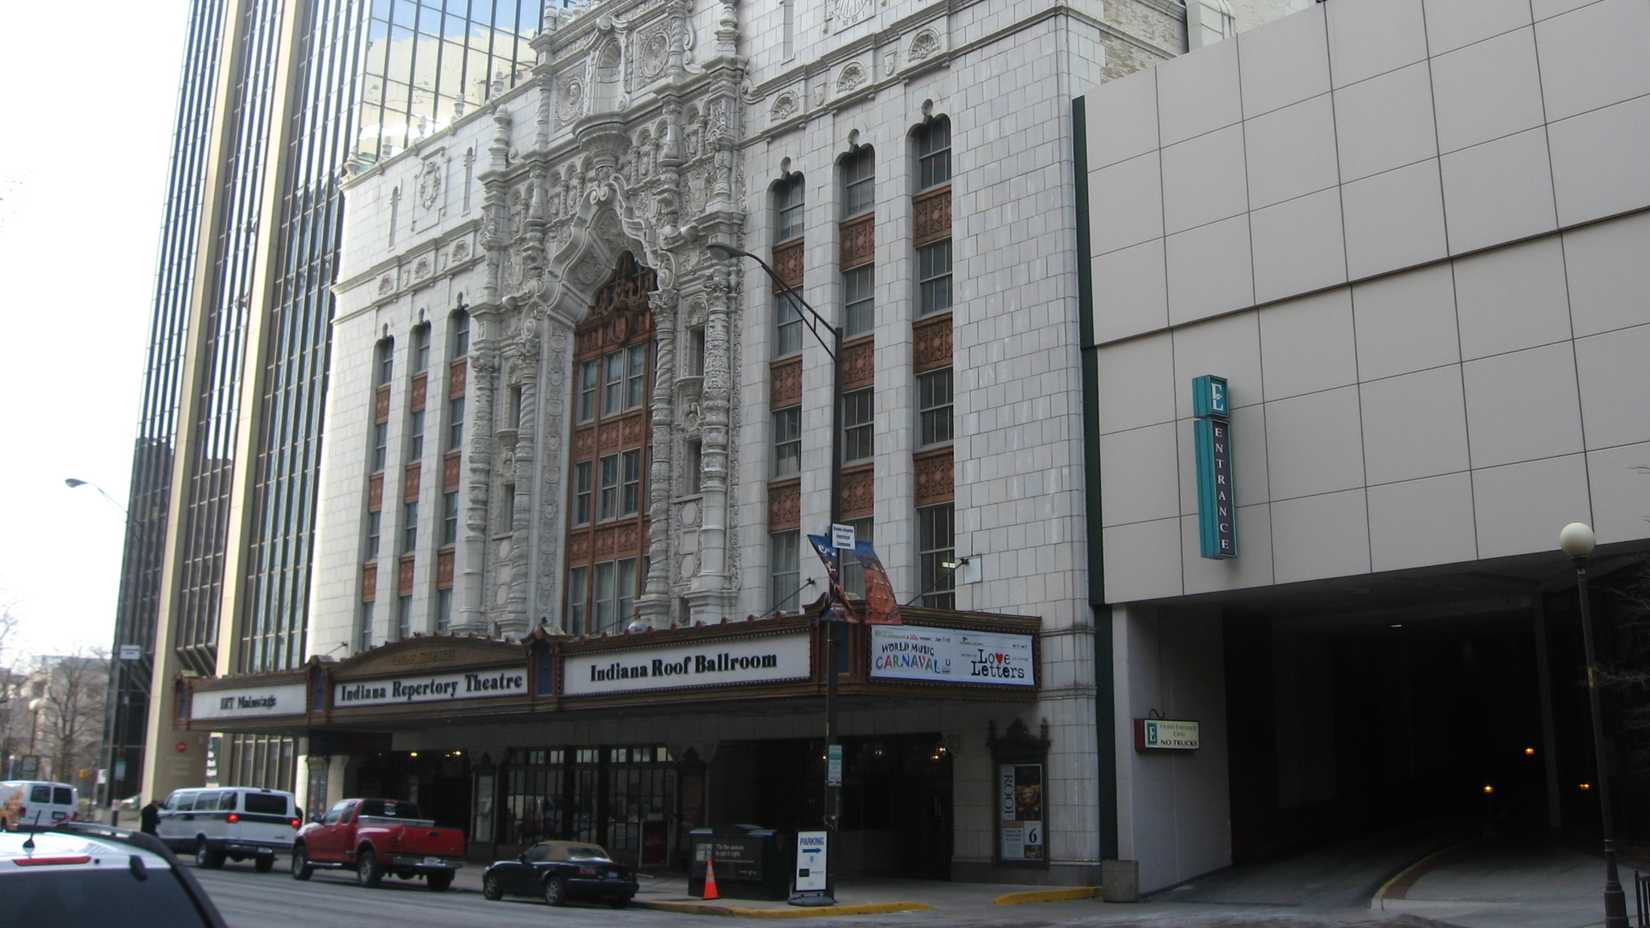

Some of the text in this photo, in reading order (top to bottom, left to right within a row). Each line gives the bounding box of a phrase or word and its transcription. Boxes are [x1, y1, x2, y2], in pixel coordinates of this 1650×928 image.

[1214, 427, 1231, 550] ENTRANCE
[882, 642, 935, 656] WORLD MUSIC
[590, 653, 777, 682] Indiana Roof Ballroom
[875, 653, 941, 674] CARNAVAL
[971, 660, 1025, 679] Letters
[341, 672, 523, 701] Indiana Repertory Theatre
